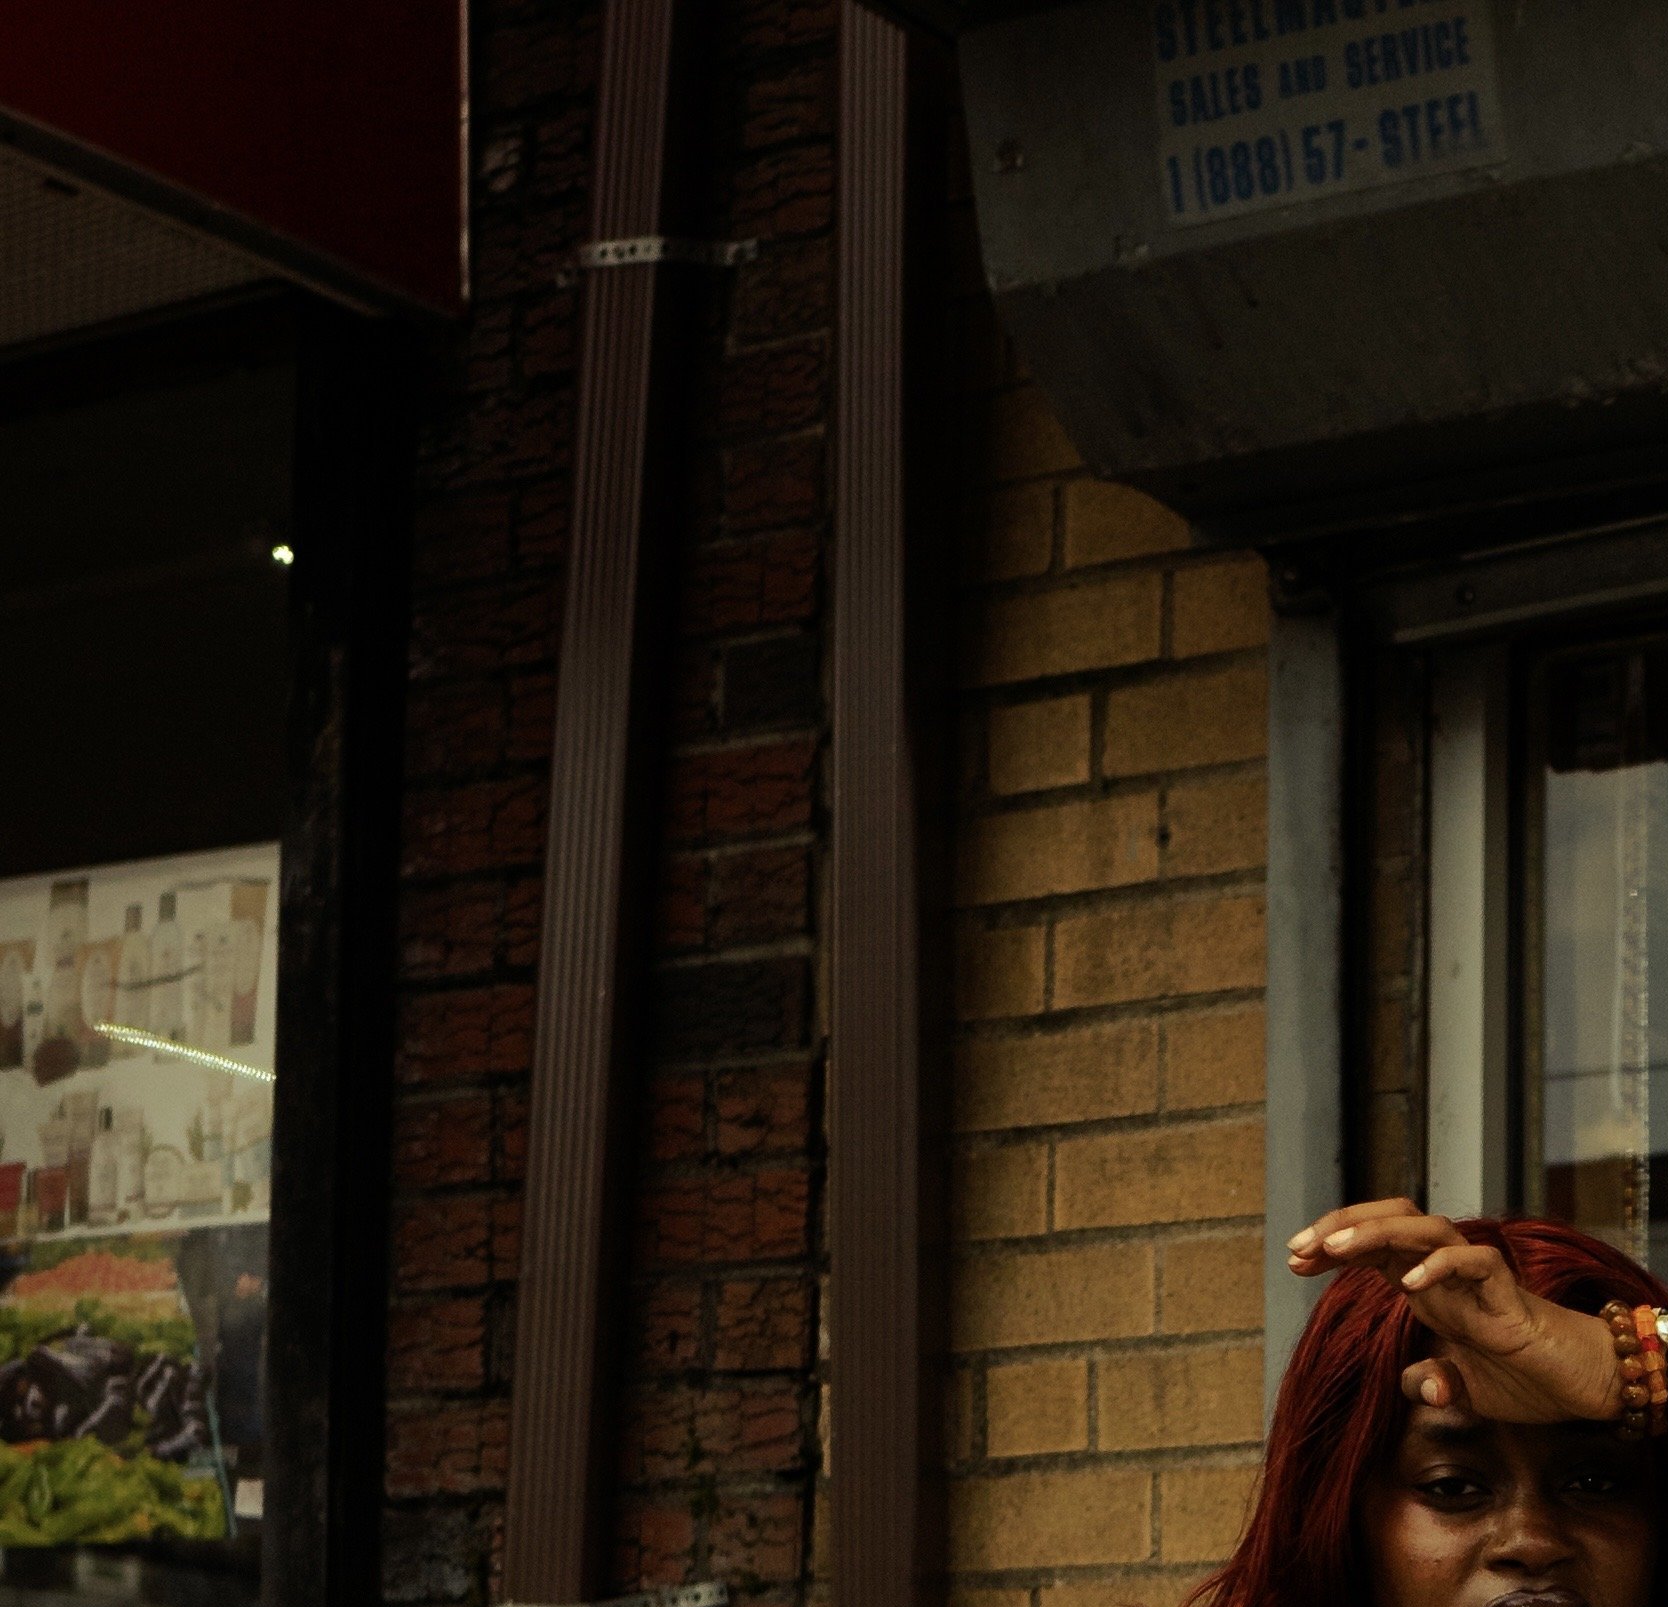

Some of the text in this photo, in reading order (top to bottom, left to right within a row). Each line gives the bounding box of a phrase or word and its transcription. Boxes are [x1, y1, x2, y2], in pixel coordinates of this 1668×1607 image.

[1169, 18, 1470, 125] SALES AND SERVICE
